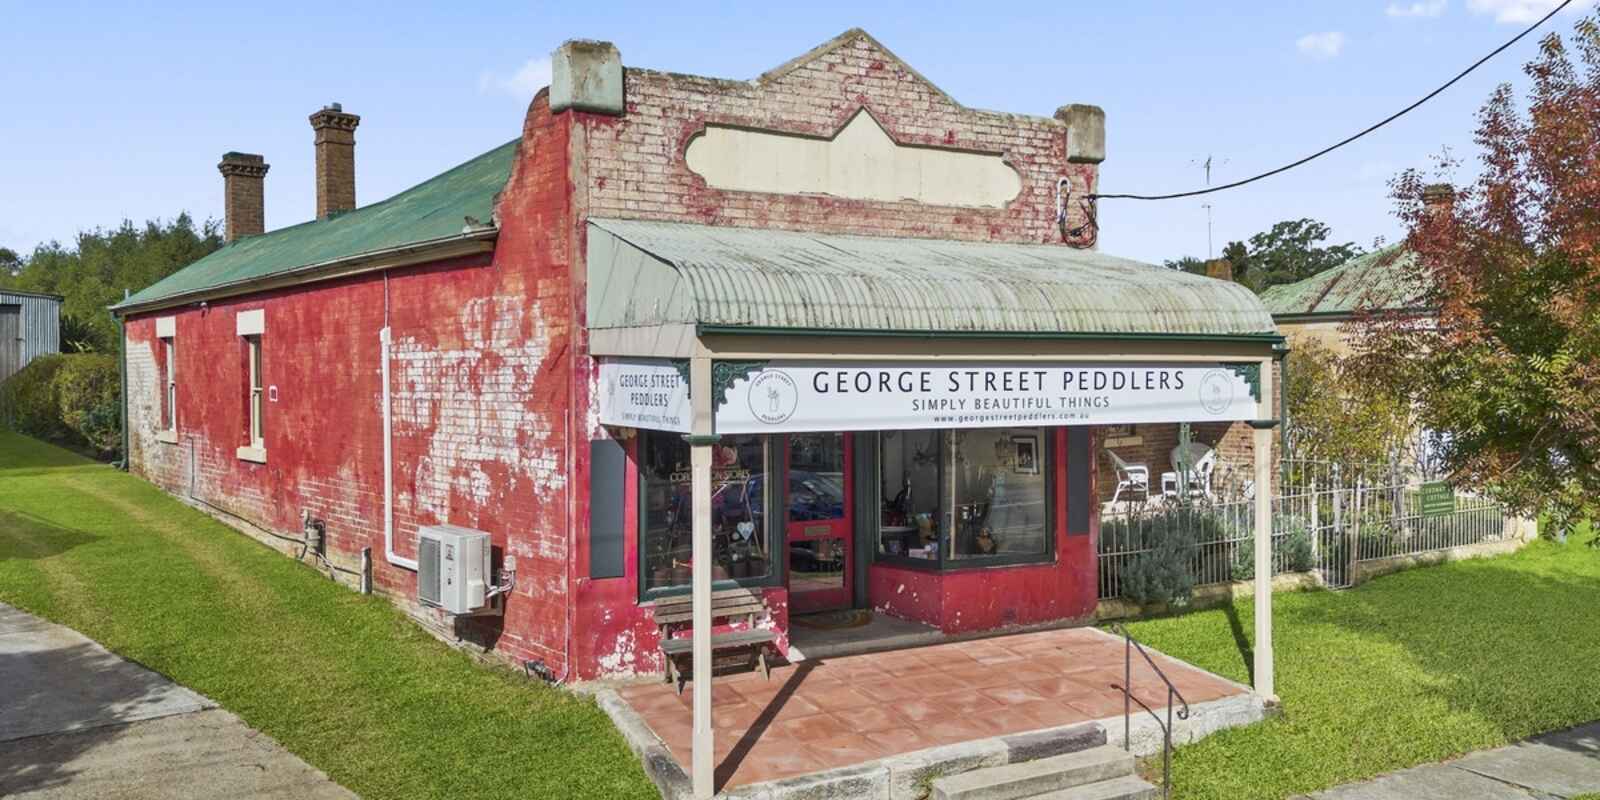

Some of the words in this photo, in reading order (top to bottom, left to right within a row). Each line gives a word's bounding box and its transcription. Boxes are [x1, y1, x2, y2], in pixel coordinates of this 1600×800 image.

[620, 374, 648, 388] GEORGE
[651, 374, 680, 389] STREET
[812, 371, 932, 393] GEORGE
[948, 370, 1047, 392] STREET
[1063, 370, 1184, 390] PEDDLERS
[630, 392, 669, 407] PEDDLERS
[912, 399, 966, 411] SIMPLY
[974, 398, 1052, 410] BEAUTIFUL
[1060, 396, 1110, 408] THINGS
